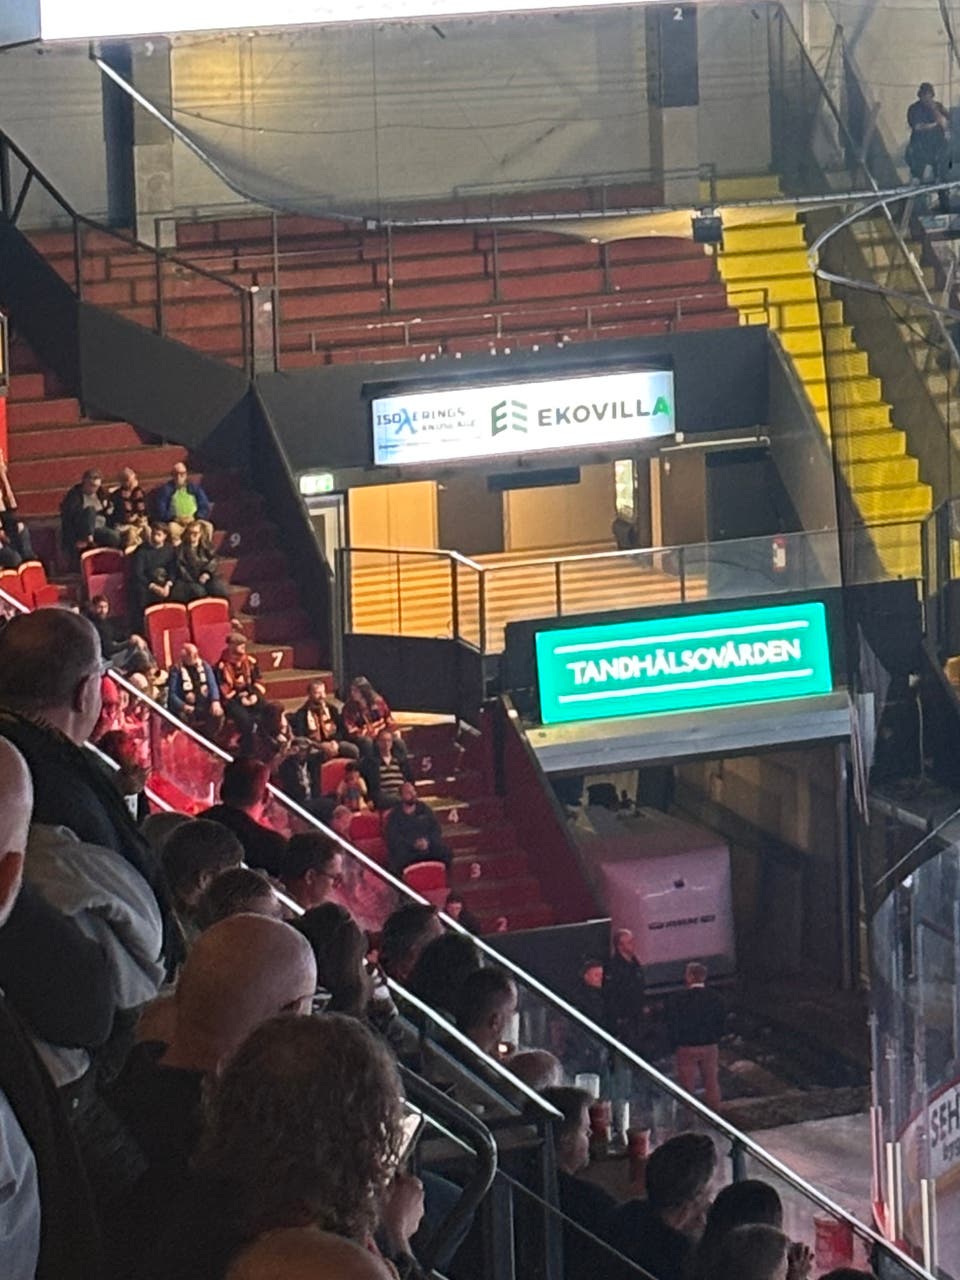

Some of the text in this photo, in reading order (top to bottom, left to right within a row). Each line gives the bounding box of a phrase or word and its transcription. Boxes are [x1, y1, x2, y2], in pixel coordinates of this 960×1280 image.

[673, 6, 684, 21] 2
[538, 396, 671, 427] EKOVILLA
[230, 532, 241, 547] 9
[249, 592, 261, 607] 8
[271, 651, 284, 667] 7
[566, 639, 802, 685] TANDHÄLSOVÅRDEN
[422, 756, 432, 772] 5
[448, 808, 459, 824] 4
[470, 862, 481, 879] 3
